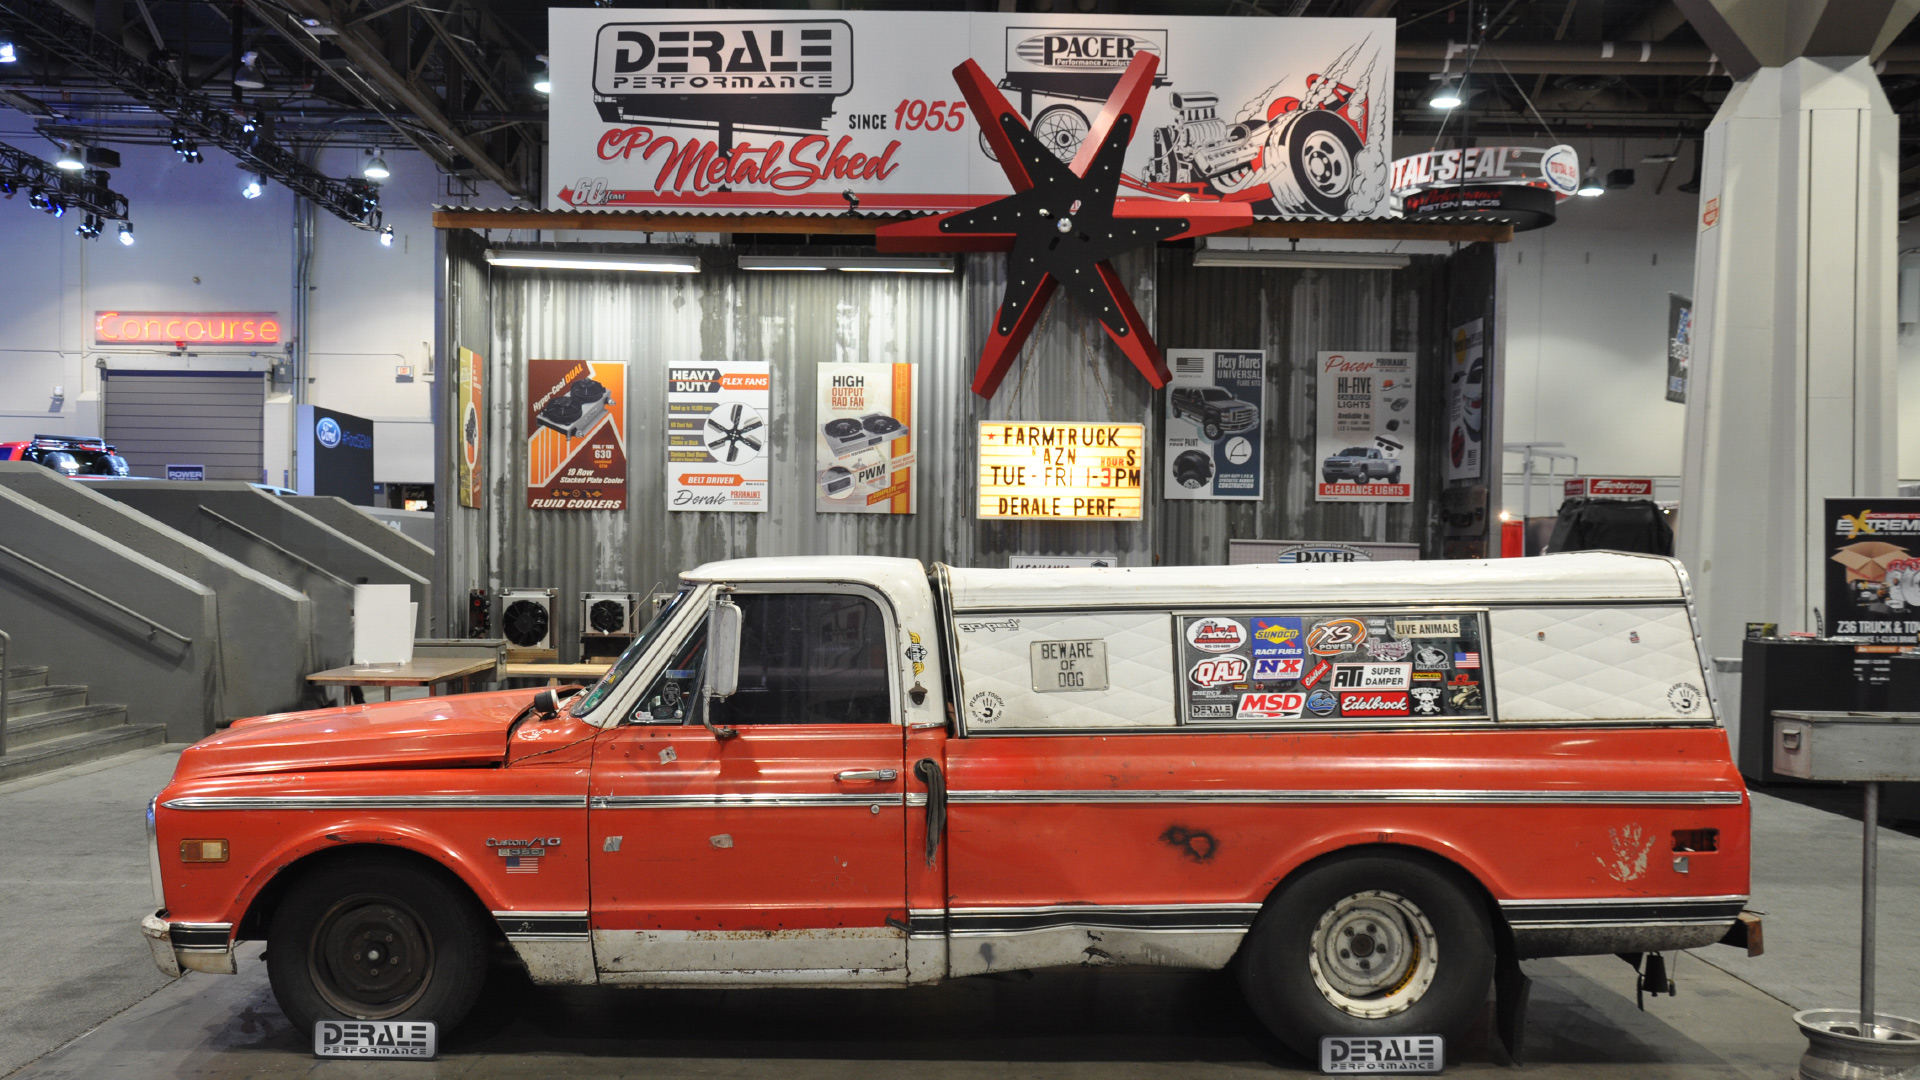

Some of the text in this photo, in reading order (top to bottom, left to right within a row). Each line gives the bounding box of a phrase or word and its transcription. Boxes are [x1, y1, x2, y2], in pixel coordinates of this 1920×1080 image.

[615, 29, 832, 73] DERALE
[1044, 36, 1134, 66] PACER
[614, 76, 832, 89] PERFORMANCE
[849, 99, 967, 132] SINCE 1955
[597, 126, 654, 161] CP
[1438, 147, 1512, 180] SEAL
[571, 177, 608, 205] 60
[1419, 201, 1458, 213] PISTON
[98, 311, 279, 341] Concourse
[1217, 354, 1260, 369] Flexy Flares
[1325, 355, 1374, 373] Pacer
[672, 370, 716, 381] HEAVY
[722, 378, 767, 386] FLEX FANS
[832, 375, 864, 387] HIGH
[1217, 369, 1261, 380] UNIVERSAL
[533, 363, 583, 412] Hyper-Cool DUAL
[676, 382, 711, 392] DUTY
[831, 387, 864, 397] OUTPUT
[1338, 377, 1371, 394] HI-FIVE
[832, 396, 864, 407] RAD FAN
[1338, 401, 1370, 409] LIGHTS
[321, 421, 336, 442] Ford
[1004, 427, 1119, 447] FARMTRUCK
[1184, 438, 1198, 447] PAINT
[595, 450, 612, 458] 630
[1044, 447, 1076, 466] AZN
[567, 468, 595, 476] 19 Row
[859, 463, 885, 483] PWM
[991, 466, 1026, 485] TUE
[1045, 467, 1073, 486] FRI
[687, 476, 706, 484] BELT
[1593, 481, 1649, 494] Sebring
[673, 489, 726, 506] Derale
[1325, 485, 1404, 496] CLEARANCE LIGHTS
[531, 499, 622, 509] FLUID COOLERS
[999, 497, 1122, 517] DERALE PERF.
[1257, 630, 1297, 639] SUNOCO
[1396, 624, 1417, 635] LIVE
[1418, 623, 1459, 634] ANIMALS
[1837, 621, 1857, 633] Z36
[1858, 621, 1893, 633] TRUCK
[1893, 621, 1903, 633] &
[1311, 625, 1353, 649] XS
[1041, 642, 1094, 659] BEWARE
[1060, 660, 1076, 670] OF
[1257, 660, 1302, 673] NX
[1371, 667, 1401, 676] SUPER
[1058, 672, 1084, 687] DOG
[1197, 660, 1244, 686] QA1
[1334, 666, 1364, 687] ATI
[1365, 677, 1404, 686] DAMPER
[969, 691, 1005, 707] PLEASE TOUCH!
[1241, 694, 1302, 711] MSD
[1342, 695, 1408, 711] Edelbrock
[1194, 706, 1231, 714] DERALE
[324, 1023, 426, 1047] DERALE
[324, 1047, 426, 1055] PERFORMANCE
[1331, 1039, 1434, 1062] DERALE
[1331, 1062, 1434, 1070] PERFORMANCE
